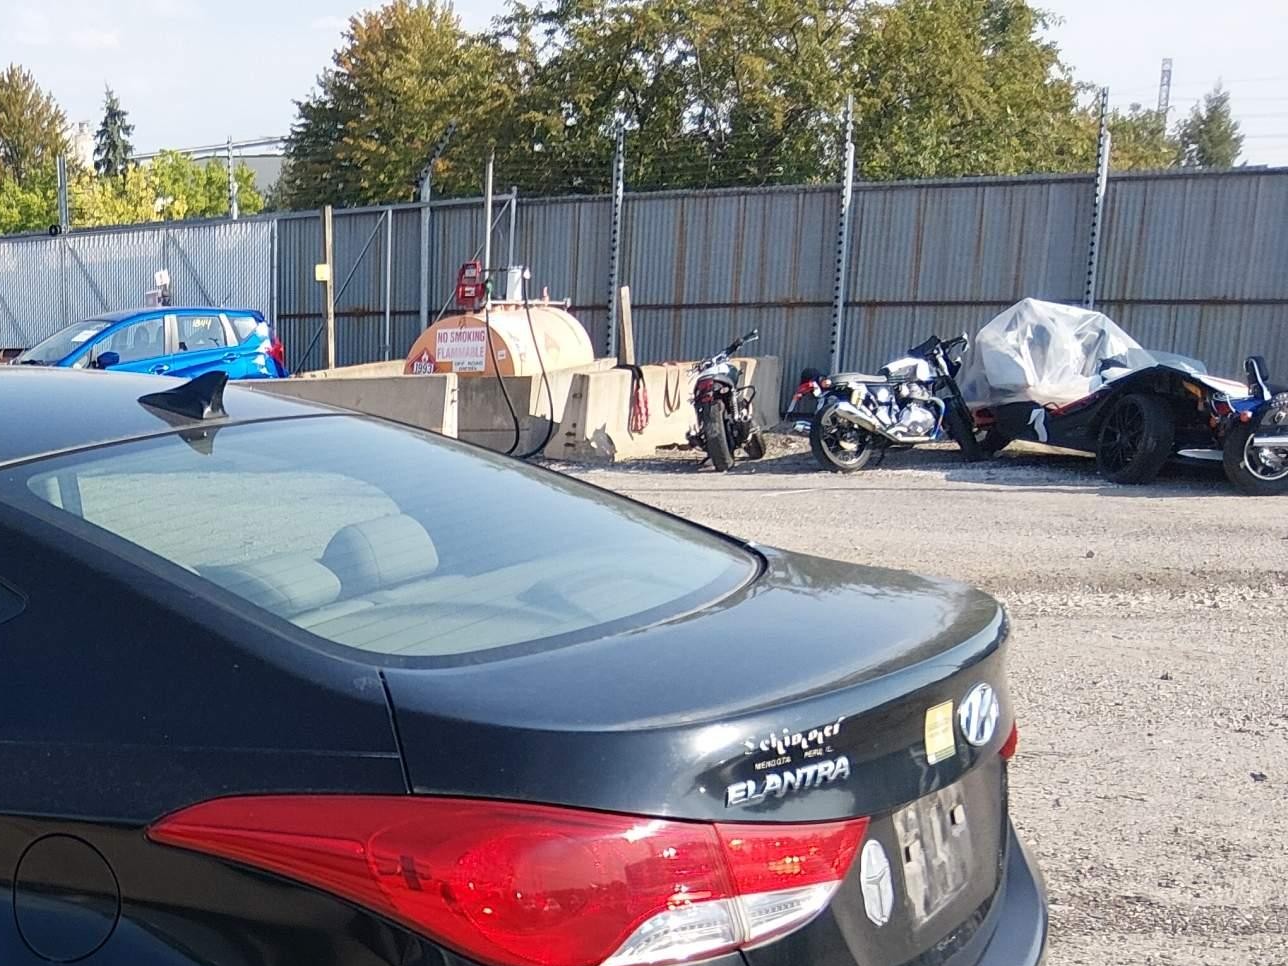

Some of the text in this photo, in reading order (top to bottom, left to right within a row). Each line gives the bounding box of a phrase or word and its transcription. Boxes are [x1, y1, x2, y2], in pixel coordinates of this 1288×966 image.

[438, 331, 485, 344] NO SMOKING
[437, 347, 484, 360] FLAMMABLE
[415, 362, 432, 374] 1993
[725, 755, 851, 808] ELANTRA
